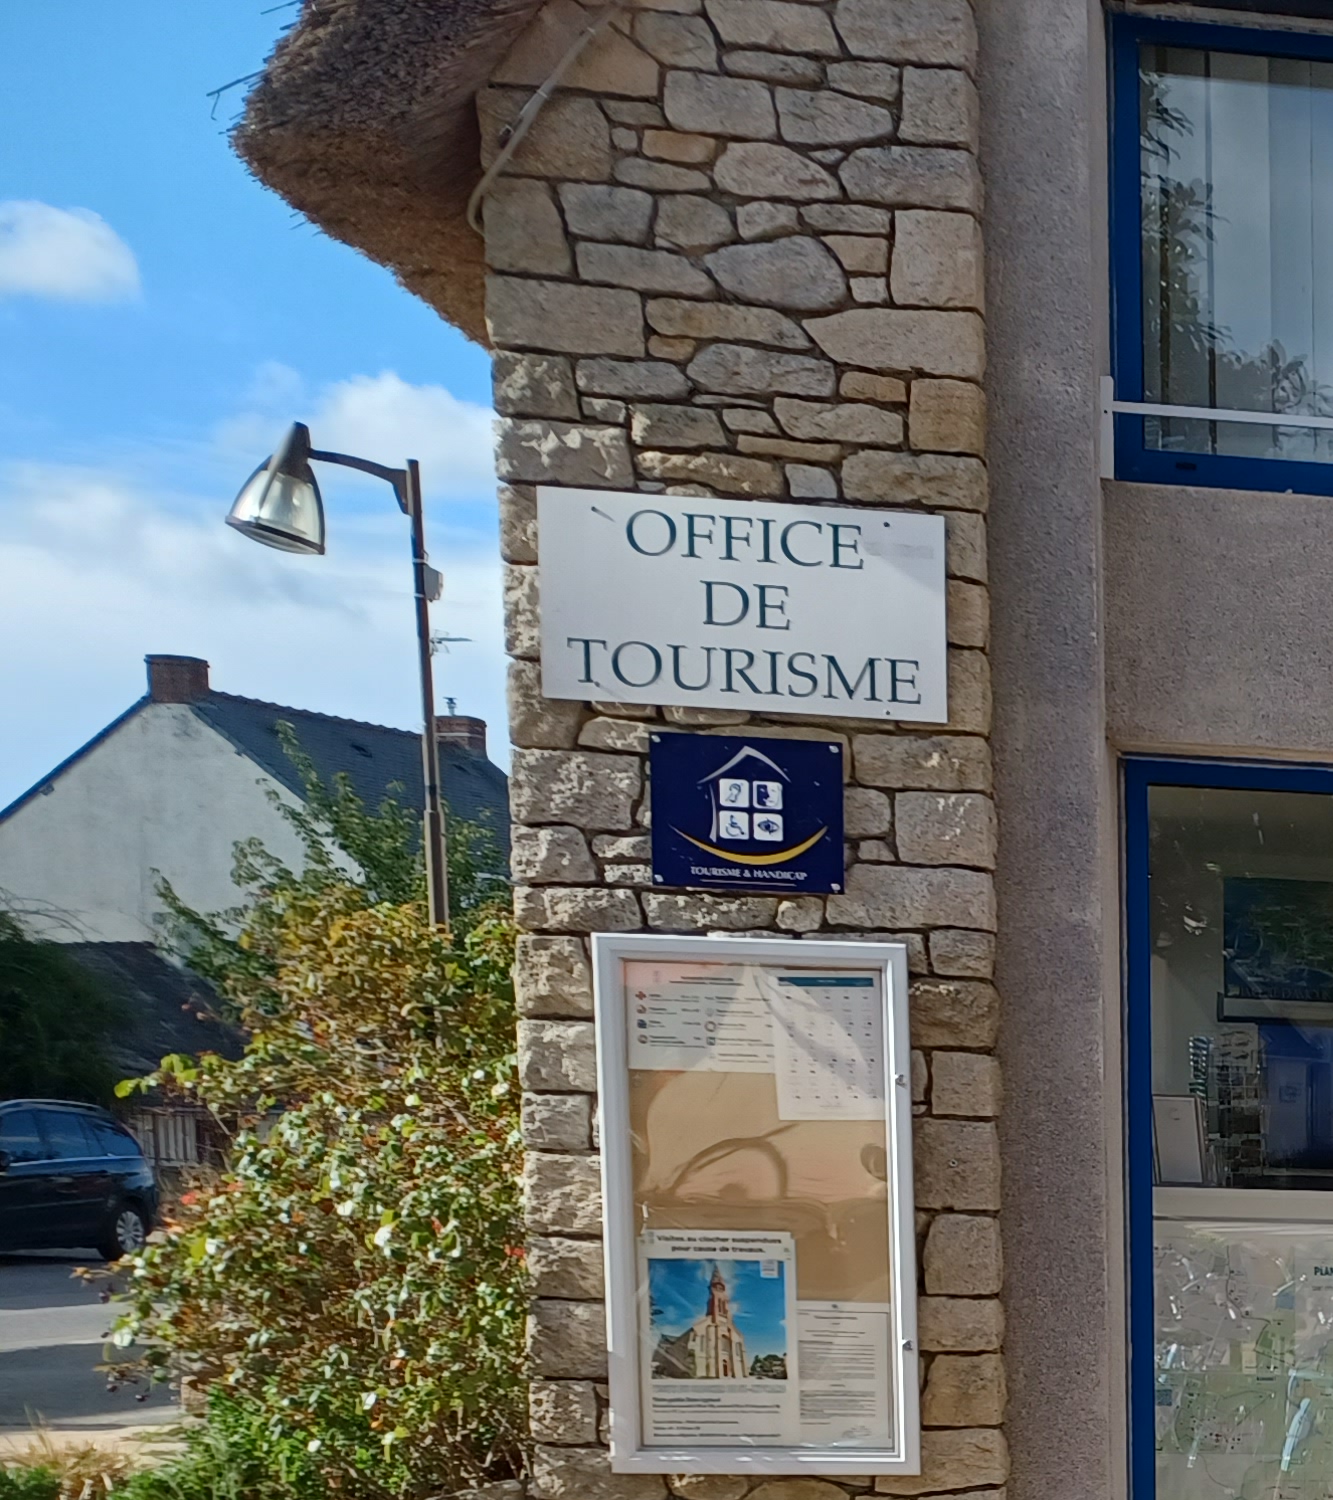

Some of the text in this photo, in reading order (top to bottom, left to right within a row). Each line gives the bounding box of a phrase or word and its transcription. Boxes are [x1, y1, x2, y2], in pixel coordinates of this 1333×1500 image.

[626, 509, 863, 569] OFFICE
[700, 580, 790, 630] DE
[567, 637, 921, 705] TOURISME
[691, 866, 741, 877] TOURISME
[754, 870, 808, 880] HANDICAP
